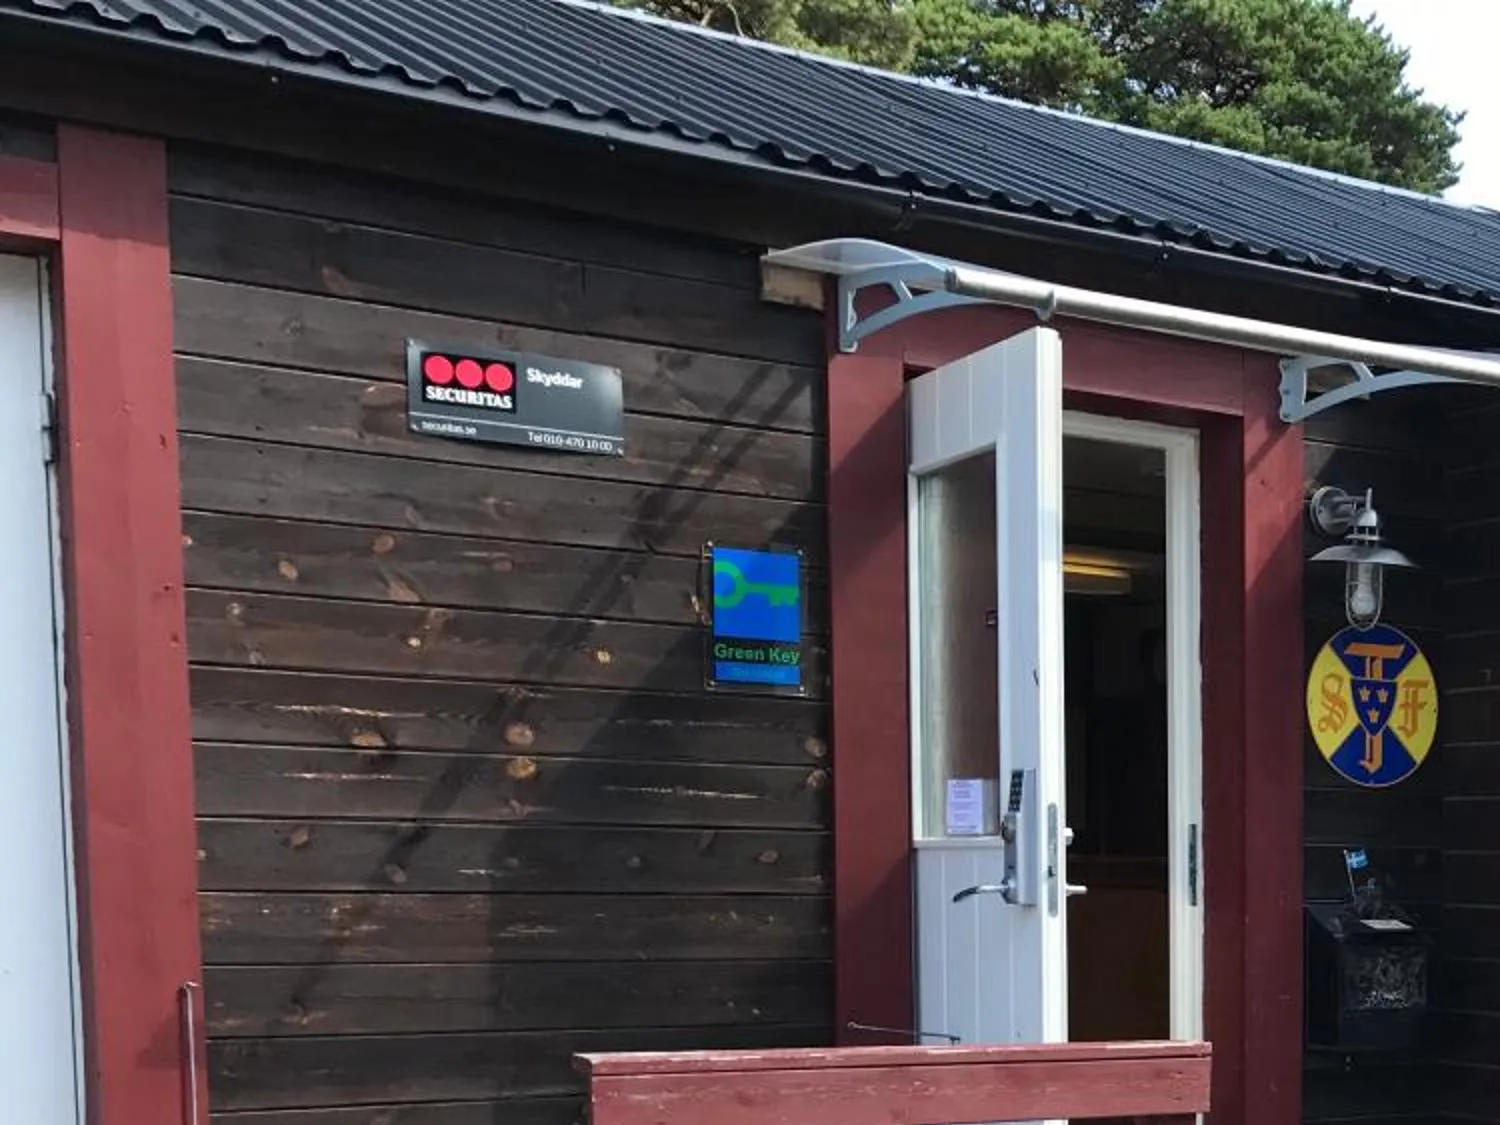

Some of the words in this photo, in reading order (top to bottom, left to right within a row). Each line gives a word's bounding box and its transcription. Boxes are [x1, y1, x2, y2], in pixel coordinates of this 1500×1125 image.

[526, 367, 584, 389] Skyddar
[425, 386, 512, 409] SECURITAS
[528, 431, 542, 443] Tel
[587, 437, 599, 450] 10
[714, 642, 765, 661] Green
[769, 647, 800, 665] Key
